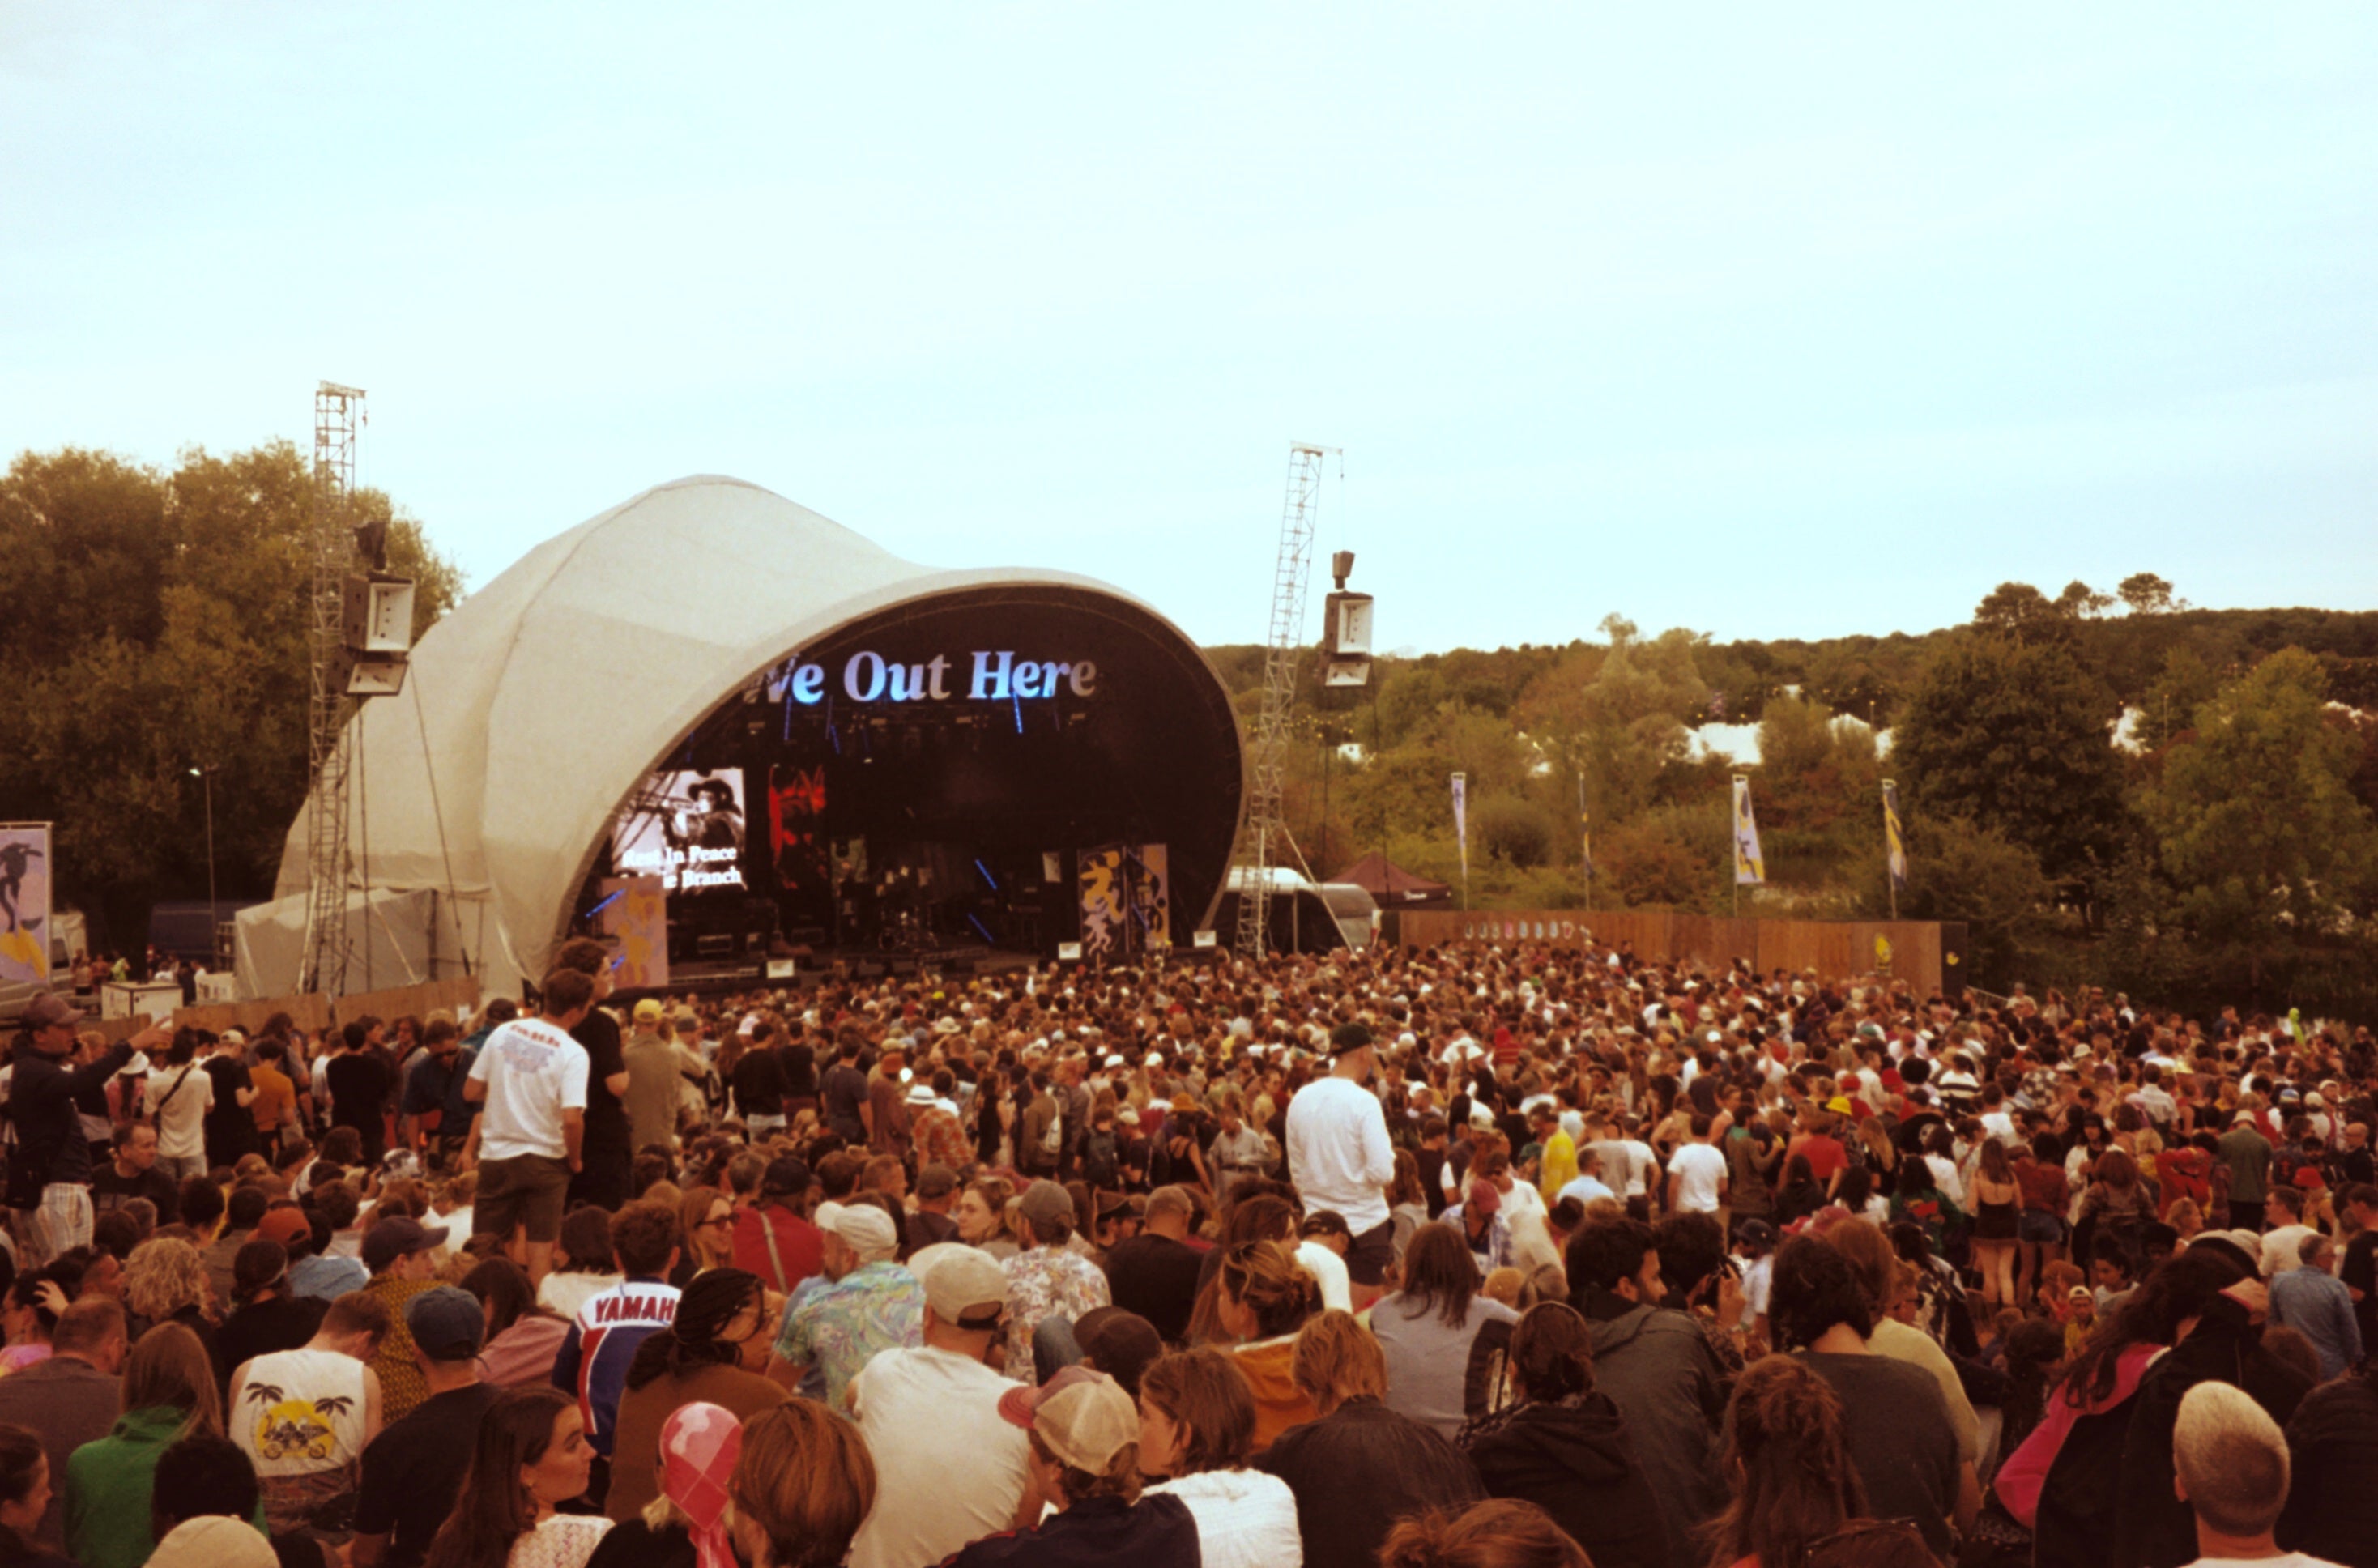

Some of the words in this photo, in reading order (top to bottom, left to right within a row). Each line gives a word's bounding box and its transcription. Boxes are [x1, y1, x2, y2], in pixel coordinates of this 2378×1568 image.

[844, 650, 952, 701] Out
[967, 650, 1097, 699] Here
[664, 847, 684, 864] In
[689, 846, 736, 863] Peace
[682, 866, 741, 888] Branch
[595, 1296, 675, 1323] YAMAH
